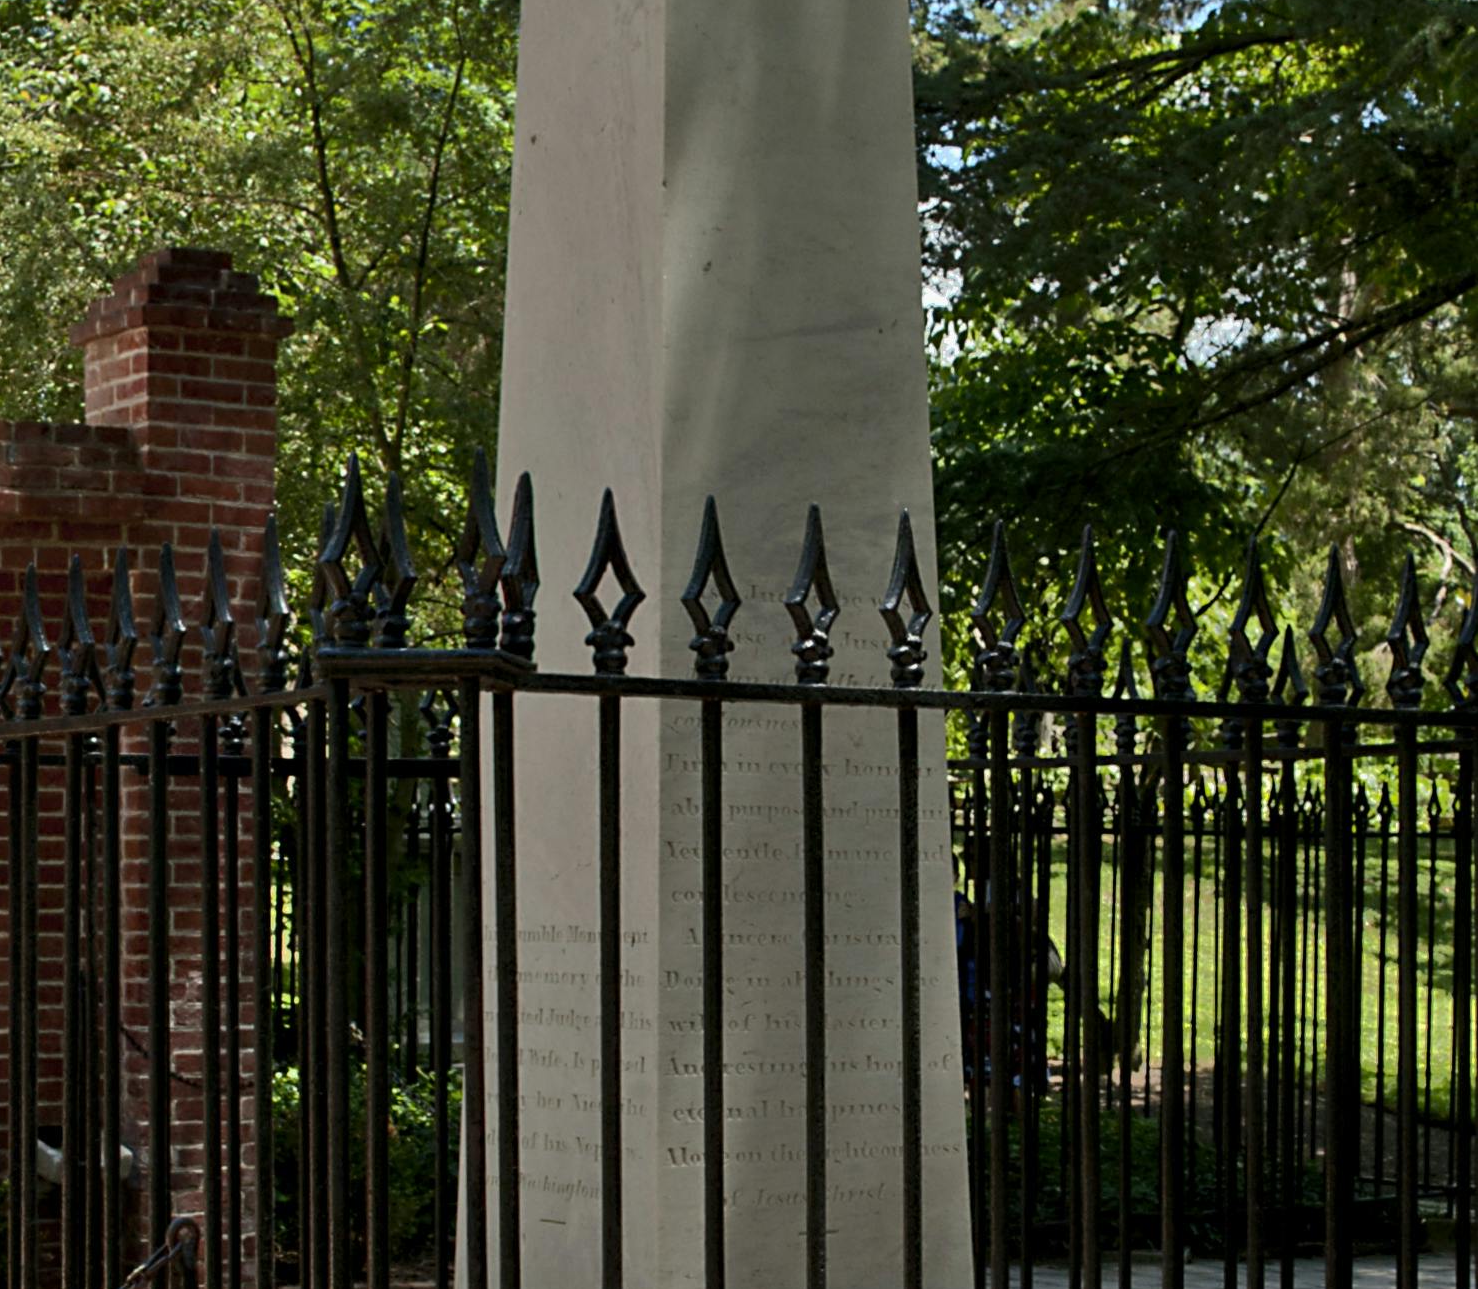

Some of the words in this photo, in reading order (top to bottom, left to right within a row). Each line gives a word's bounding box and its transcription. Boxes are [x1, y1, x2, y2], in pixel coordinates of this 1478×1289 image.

[824, 800, 860, 818] nd
[826, 969, 896, 993] hings
[727, 1013, 757, 1031] of
[764, 1013, 801, 1031] his
[662, 1056, 704, 1076] An
[927, 1053, 954, 1072] of
[672, 1099, 769, 1122] etenal
[735, 1151, 763, 1163] on
